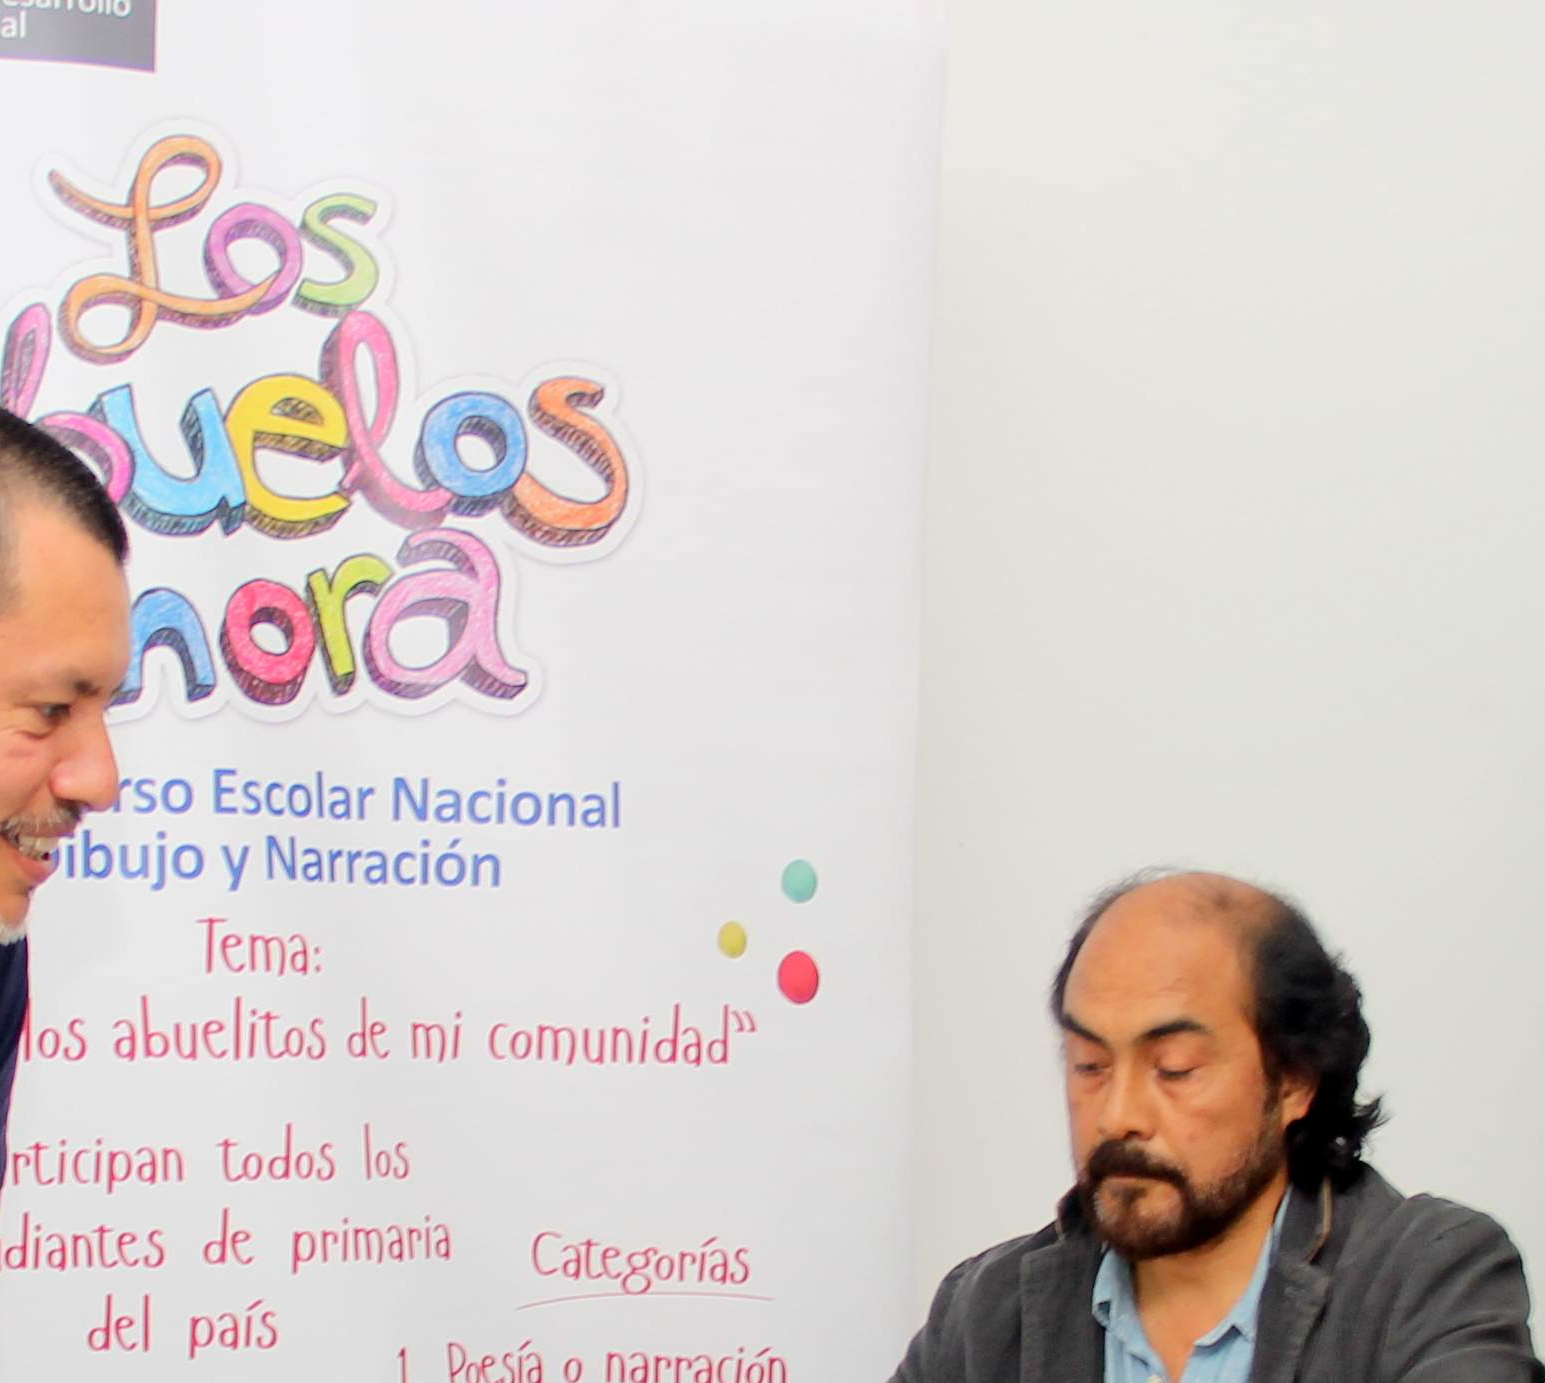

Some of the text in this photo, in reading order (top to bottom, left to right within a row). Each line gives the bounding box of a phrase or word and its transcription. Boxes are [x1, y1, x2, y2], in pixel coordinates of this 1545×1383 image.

[48, 134, 378, 365] Los
[214, 769, 374, 819] Escolar
[393, 777, 619, 828] Nacional
[50, 829, 500, 891] ibujo y Narración
[199, 918, 320, 976] Tema:
[114, 996, 326, 1061] abuelitos
[348, 997, 389, 1059] de
[412, 1012, 461, 1062] mi
[12, 1123, 409, 1194] rticipan todos los
[203, 1208, 253, 1264] de
[292, 1216, 450, 1274] primaria
[532, 1231, 751, 1294] Categorías
[88, 1295, 277, 1359] del país
[564, 1358, 582, 1383] o
